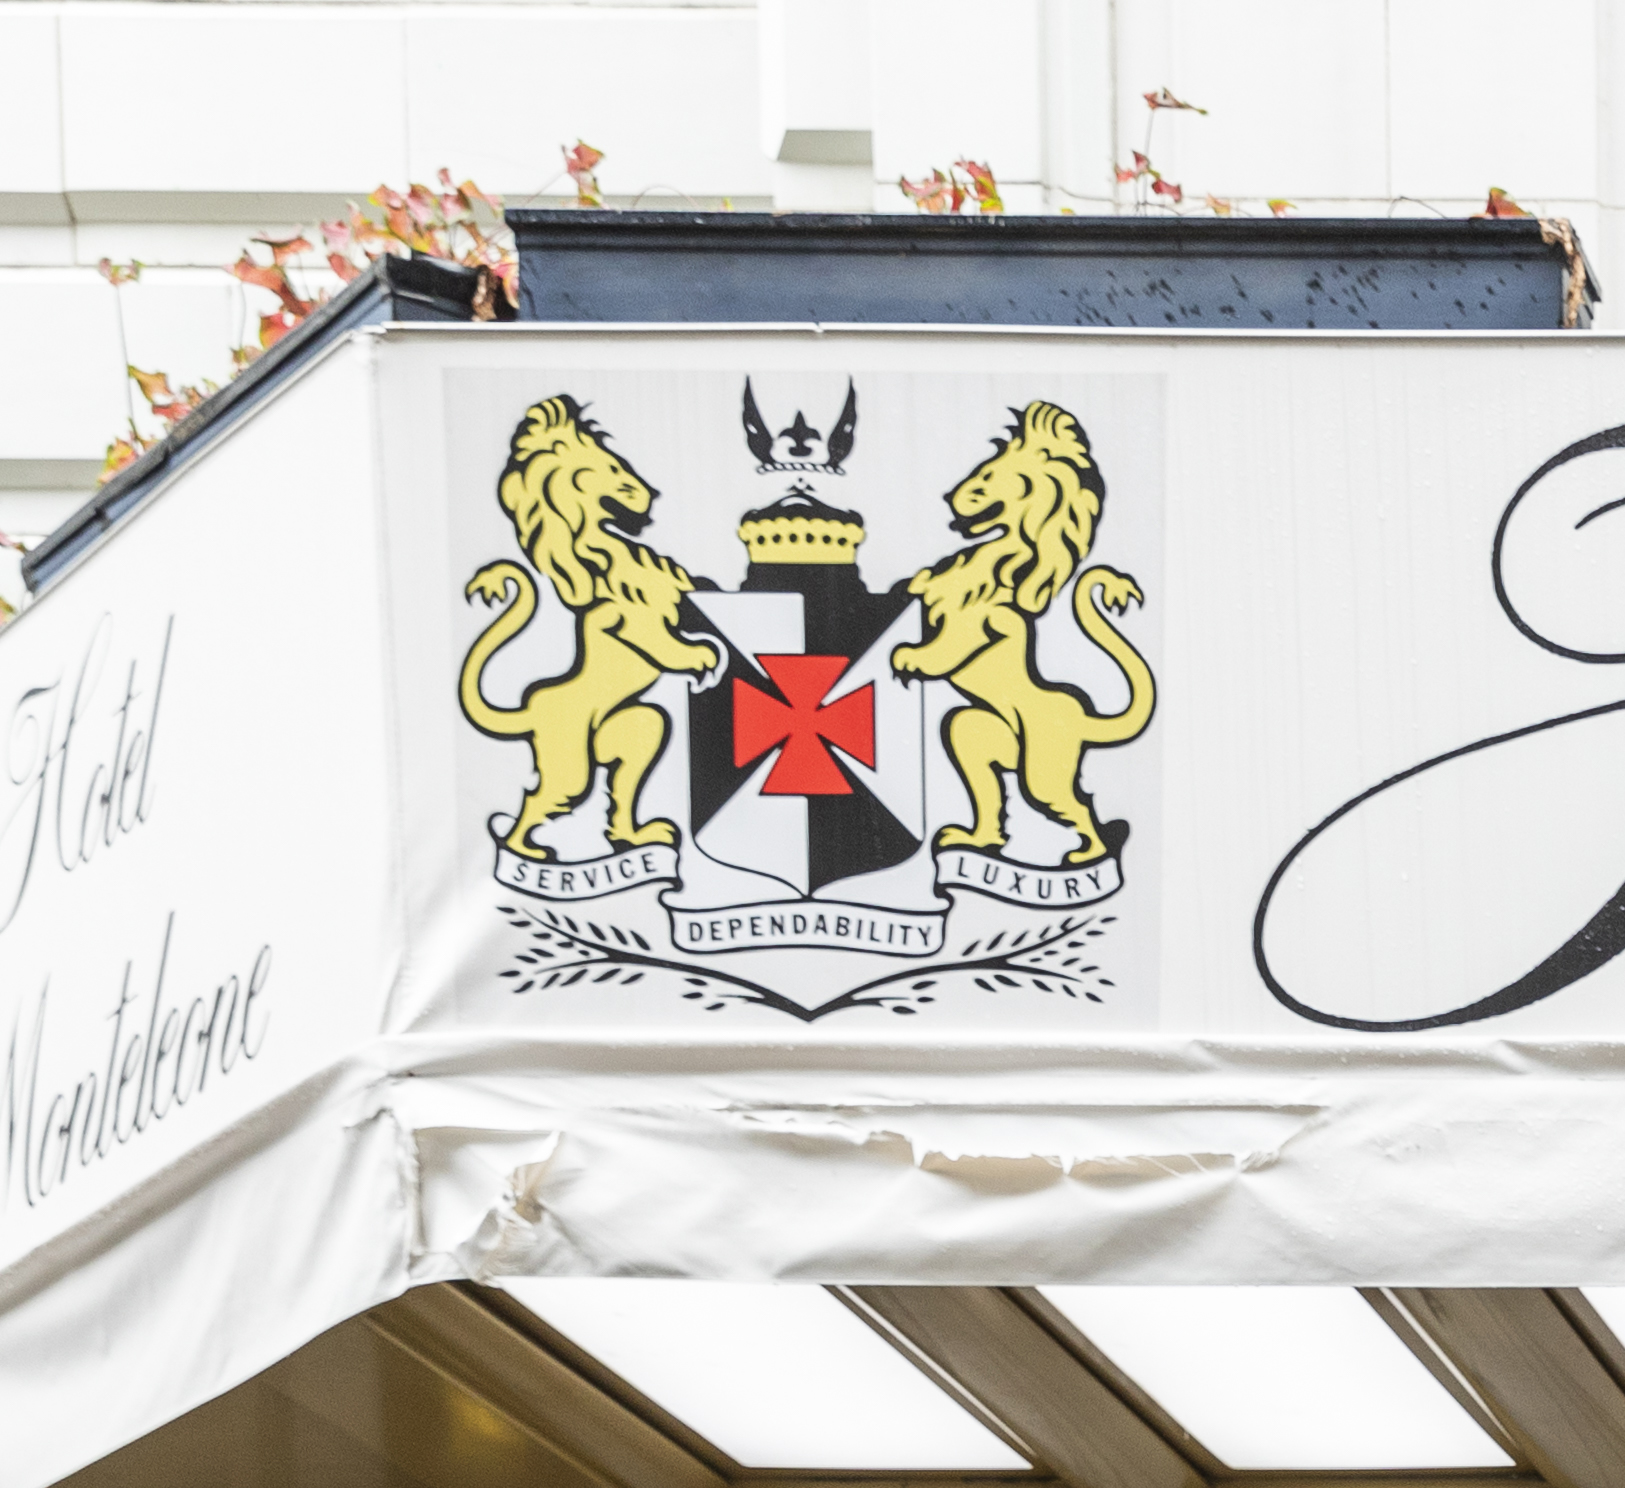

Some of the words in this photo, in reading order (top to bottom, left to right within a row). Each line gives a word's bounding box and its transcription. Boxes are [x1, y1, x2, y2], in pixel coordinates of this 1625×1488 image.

[0, 611, 175, 935] Hotel
[512, 853, 658, 891] SERVICE
[956, 857, 1104, 897] LUXURY
[688, 913, 933, 947] DEPENDABILITY
